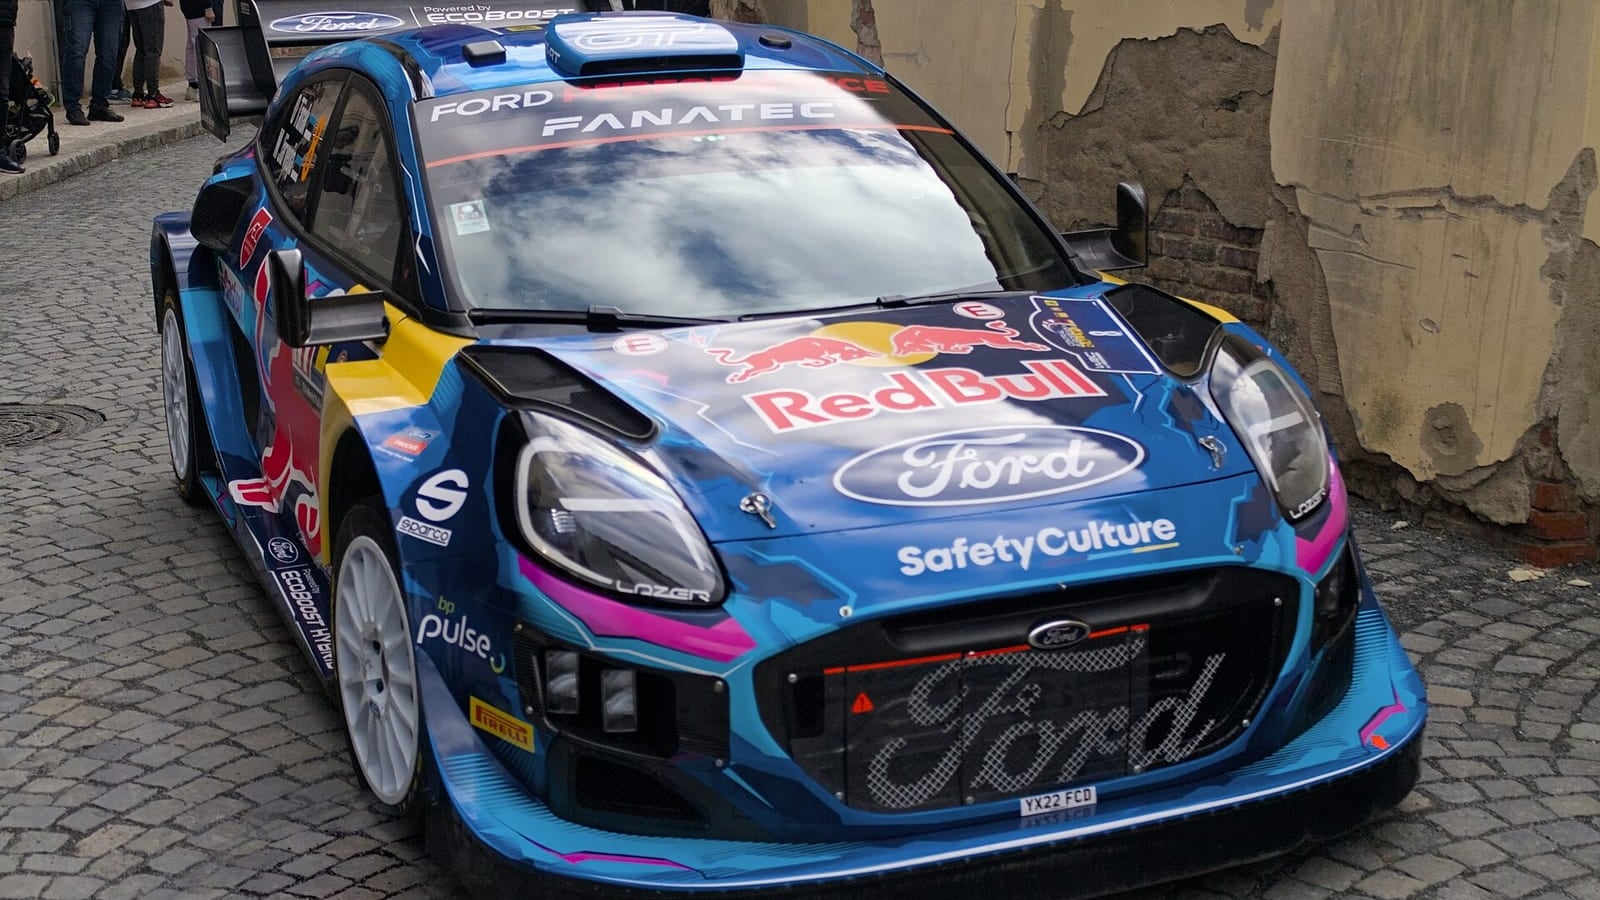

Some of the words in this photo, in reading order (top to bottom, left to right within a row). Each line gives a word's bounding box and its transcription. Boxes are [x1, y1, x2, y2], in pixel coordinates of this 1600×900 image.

[295, 15, 379, 31] Ford
[423, 5, 475, 13] Powered
[477, 4, 492, 12] by
[426, 8, 575, 23] ECOBOOST
[430, 90, 554, 122] FORD
[541, 102, 835, 137] FANATEC
[744, 373, 943, 433] Red
[920, 360, 1108, 406] Bull
[897, 433, 1095, 498] Ford
[400, 517, 449, 541] sparco
[897, 518, 1177, 577] SafetyCulture
[280, 570, 326, 626] ECOBOOST
[437, 596, 455, 615] bp
[416, 614, 491, 659] pulse
[1043, 627, 1079, 645] Ford
[475, 704, 529, 746] PIRELLI
[866, 637, 1226, 809] Ford
[1025, 794, 1061, 812] YX22
[1065, 788, 1092, 805] FCD
